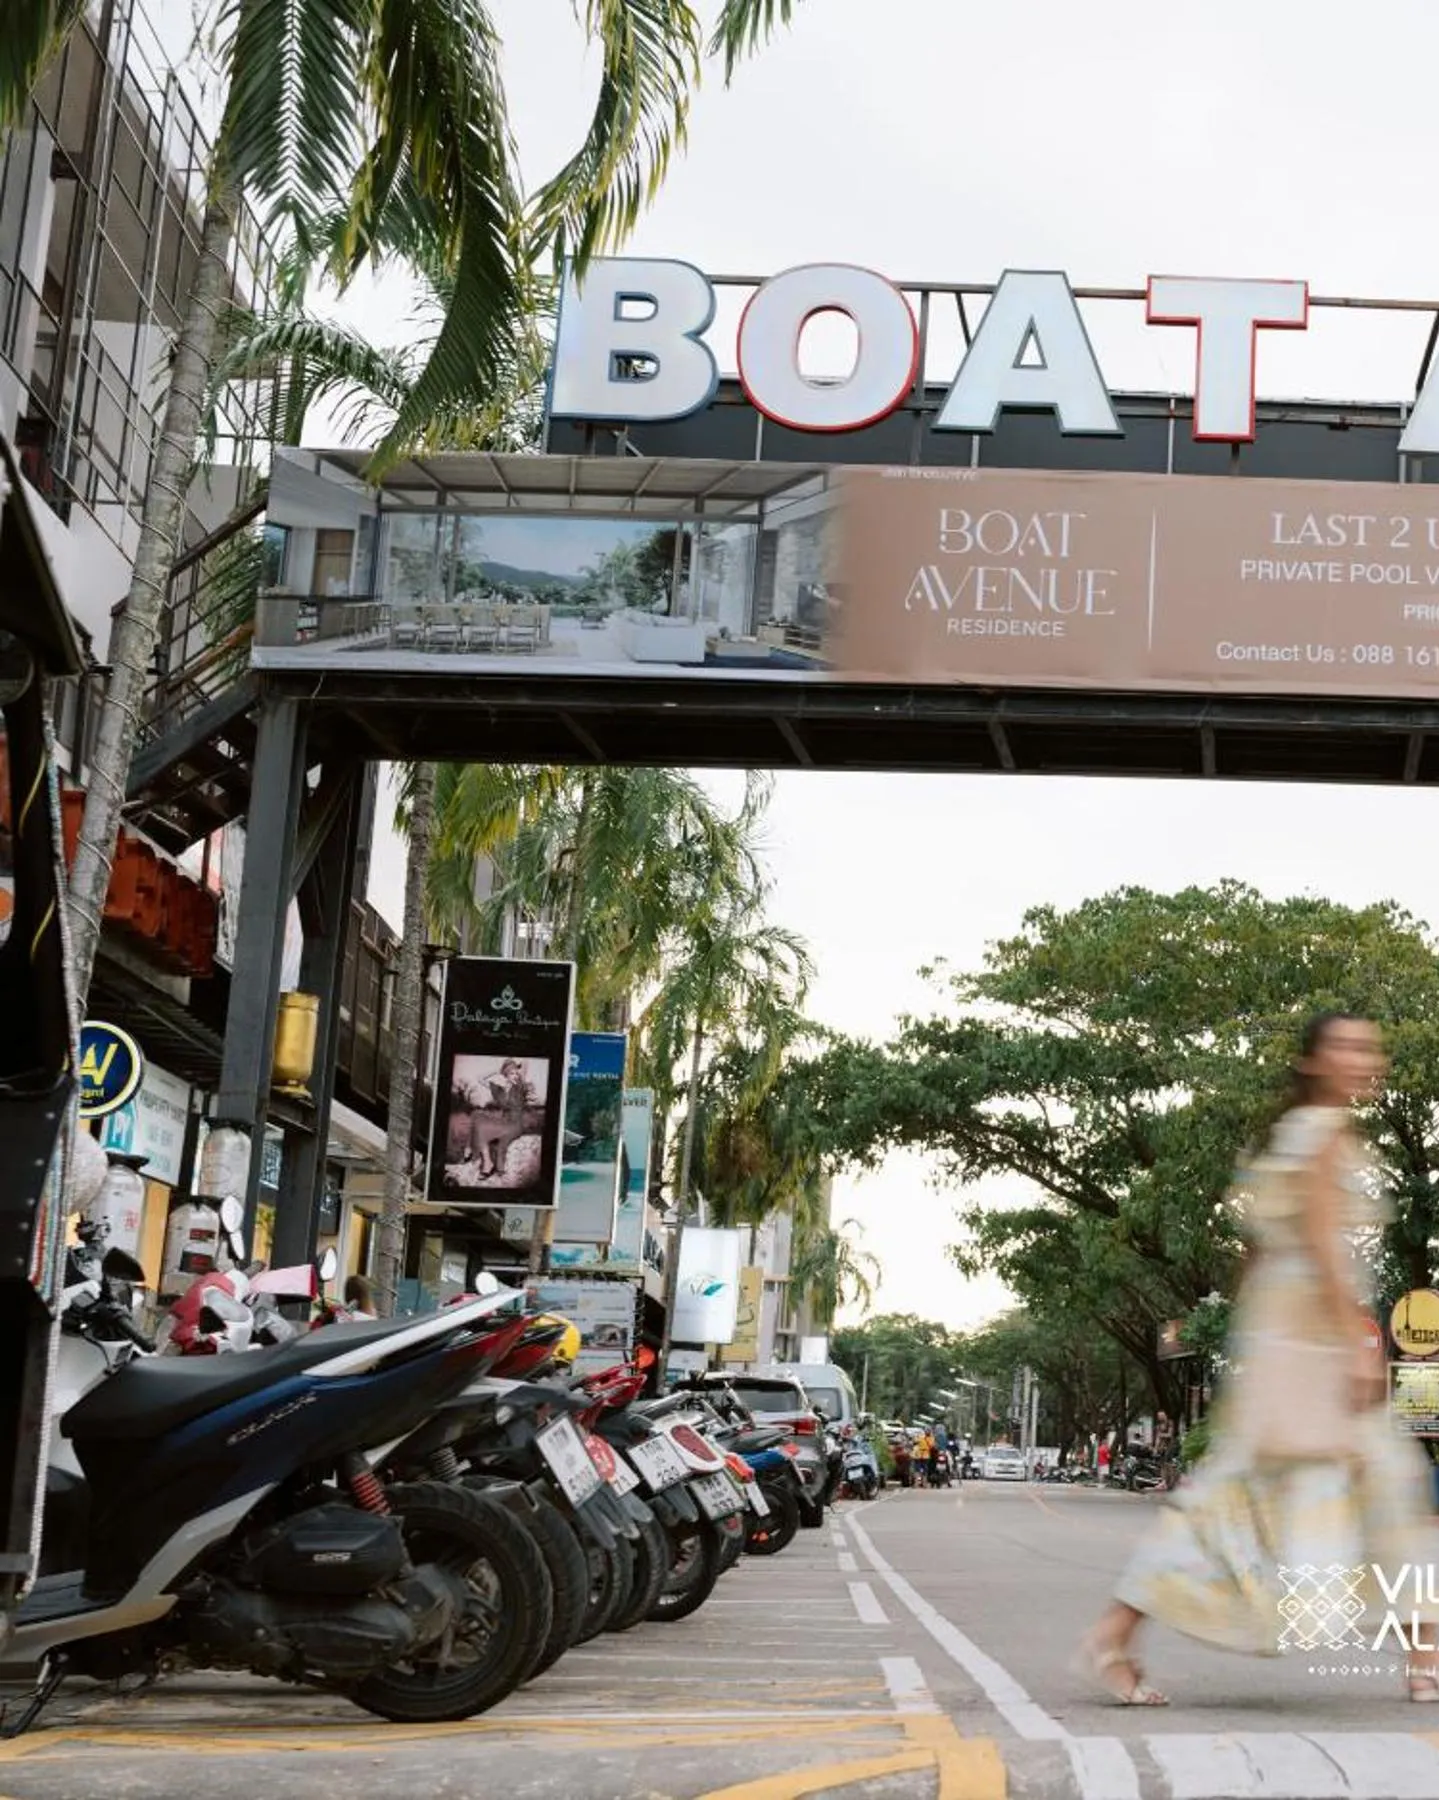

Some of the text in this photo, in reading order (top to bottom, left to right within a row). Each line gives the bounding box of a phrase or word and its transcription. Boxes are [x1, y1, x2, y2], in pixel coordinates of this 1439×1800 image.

[547, 255, 1308, 444] BOAT
[938, 508, 1087, 558] BOAT
[1272, 511, 1377, 547] LAST
[1389, 516, 1411, 549] 2
[904, 564, 1119, 616] AVENUE
[1240, 558, 1343, 583] PRIVATE
[1350, 563, 1419, 585] POOL
[946, 617, 1068, 638] RESIDENCE
[1216, 640, 1300, 663] Contact
[1306, 643, 1336, 664] Us
[1352, 644, 1395, 665] 088
